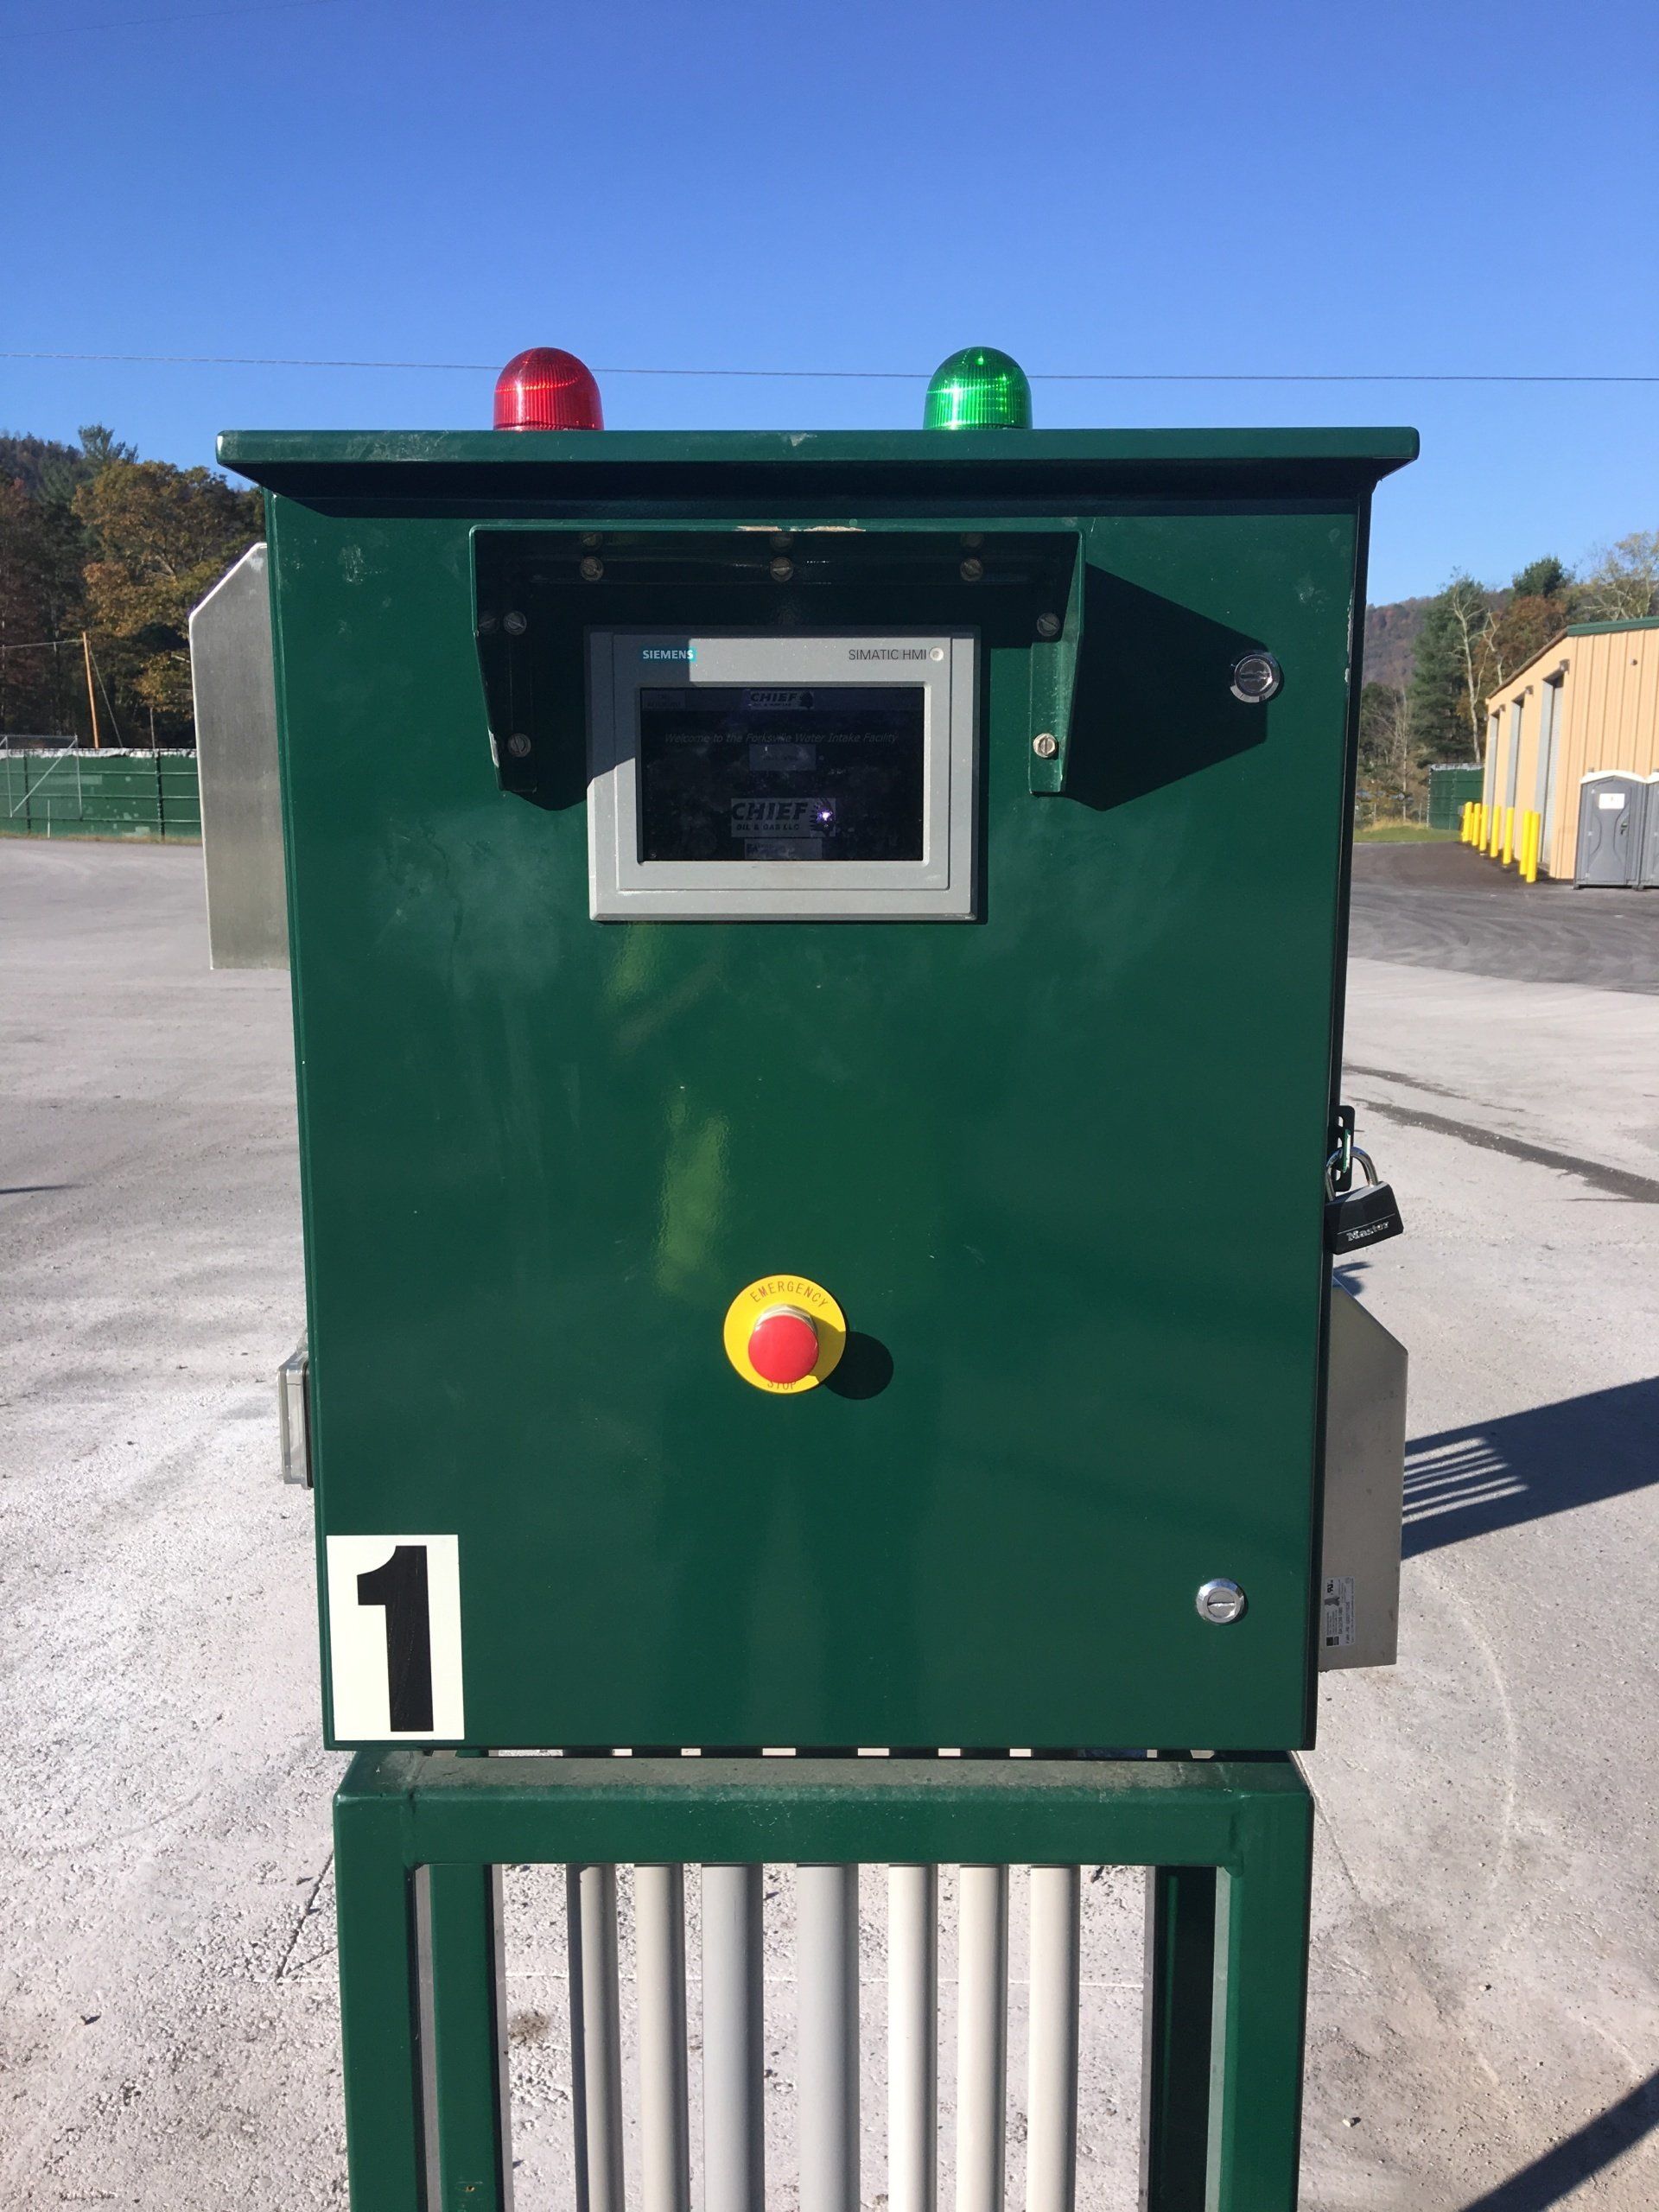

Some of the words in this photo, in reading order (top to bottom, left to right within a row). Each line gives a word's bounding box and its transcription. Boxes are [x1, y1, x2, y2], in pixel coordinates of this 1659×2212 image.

[642, 650, 694, 659] SIEMENS
[849, 649, 899, 660] SIMATIC
[903, 649, 927, 660] HMI
[750, 693, 798, 702] CHIEF
[664, 733, 710, 743] Welcome
[713, 733, 724, 743] to
[725, 733, 743, 743] the
[794, 733, 823, 743] Water
[826, 733, 861, 743] Intake
[863, 733, 898, 745] Facility
[732, 802, 809, 820] CHIEF
[1346, 1222, 1389, 1241] Master
[749, 1281, 829, 1307] EMERGENCY
[767, 1380, 797, 1390] STOP
[357, 1545, 434, 1732] 1
